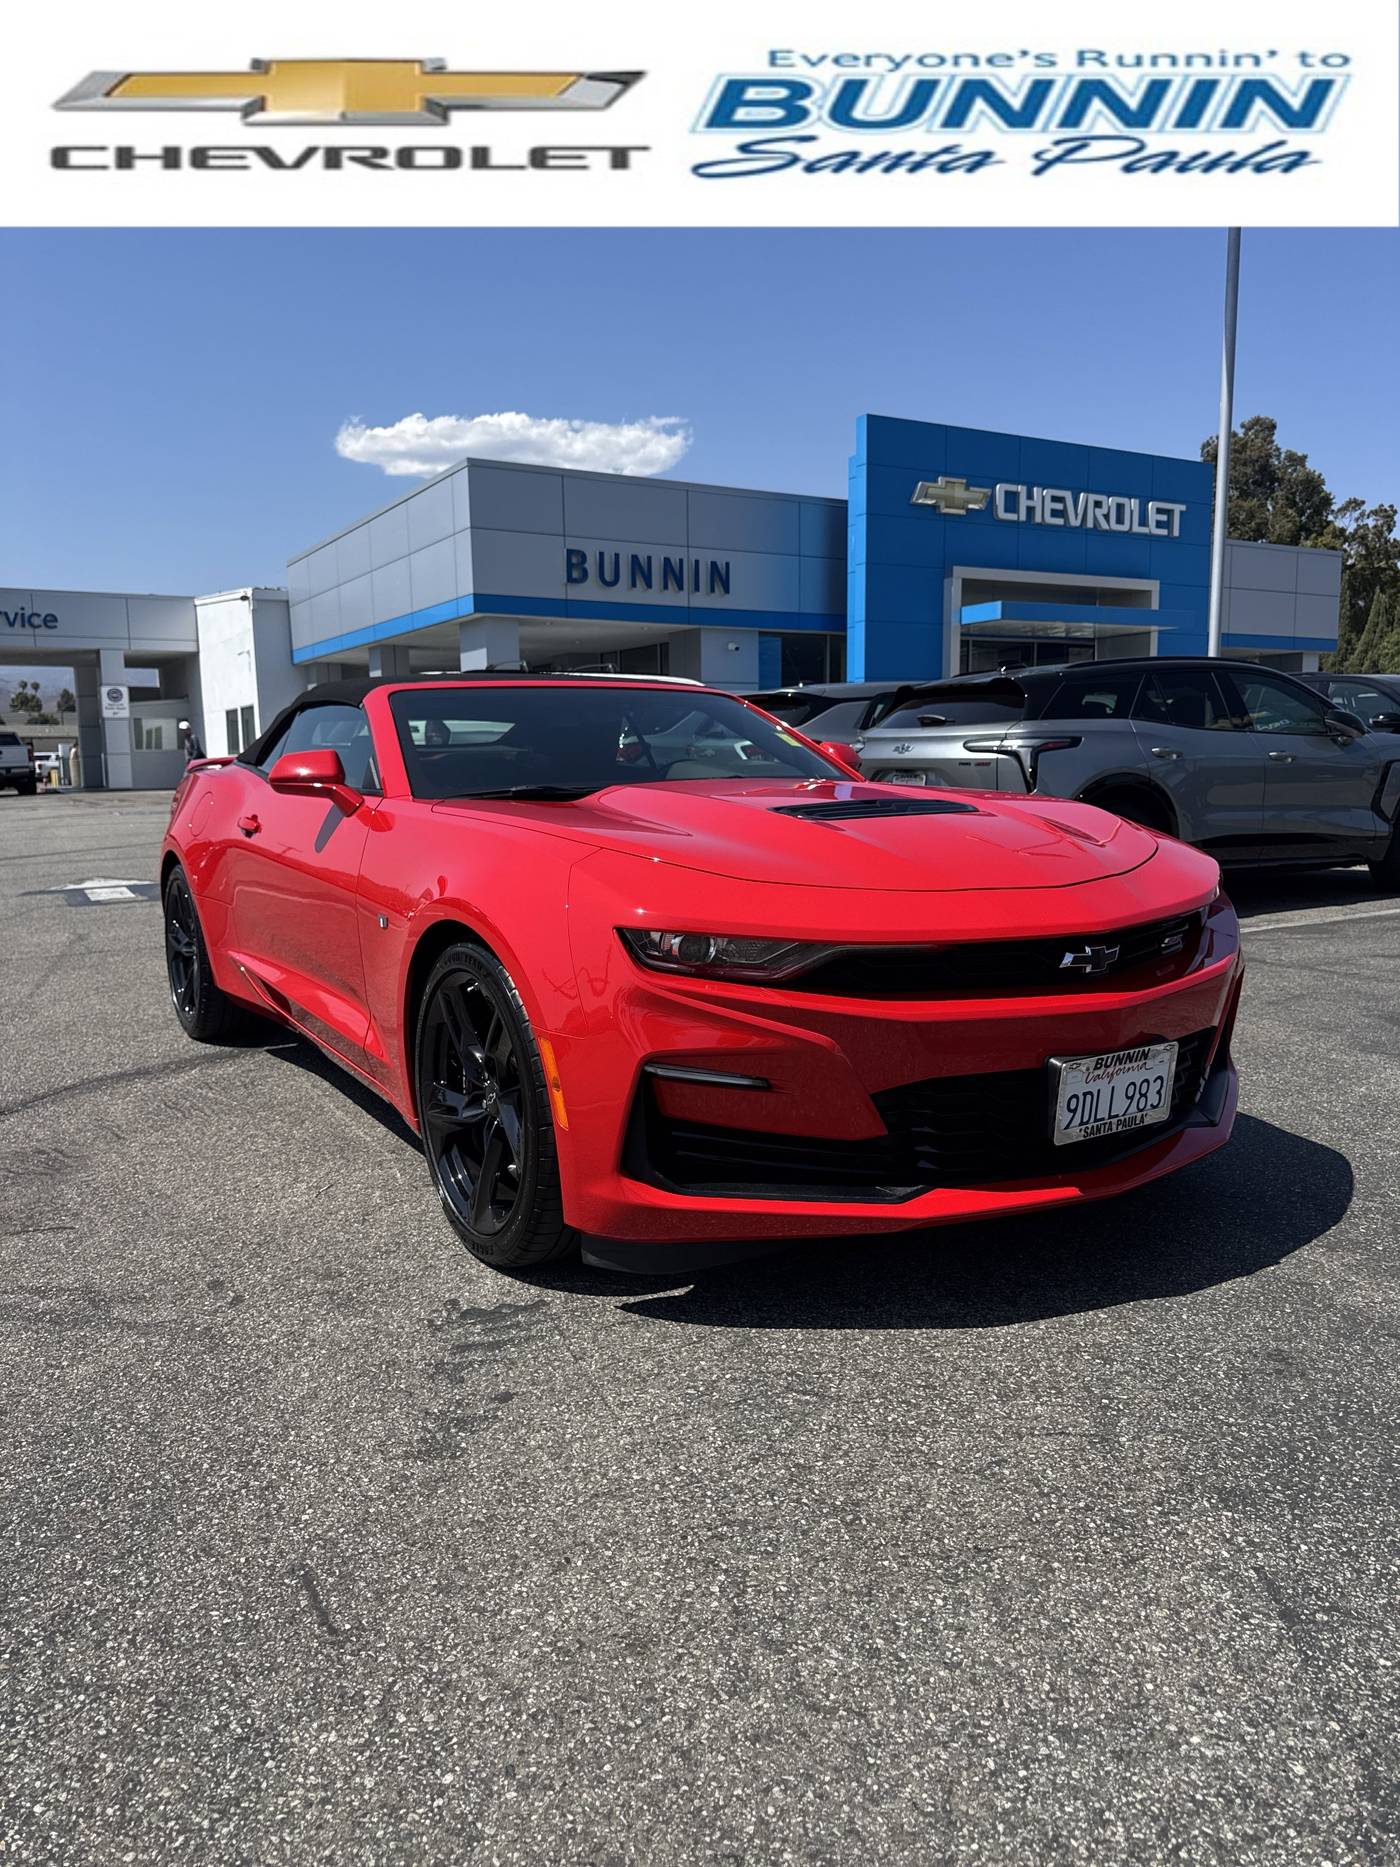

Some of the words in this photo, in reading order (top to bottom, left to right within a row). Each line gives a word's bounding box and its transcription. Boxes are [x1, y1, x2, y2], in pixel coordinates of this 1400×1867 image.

[995, 483, 1187, 537] CHEVROLET
[565, 548, 730, 595] BUNNIN
[0, 606, 59, 630] vice
[1084, 1061, 1154, 1085] California
[1093, 1048, 1151, 1071] BUNNIN
[1063, 1075, 1165, 1131] 9DLL983
